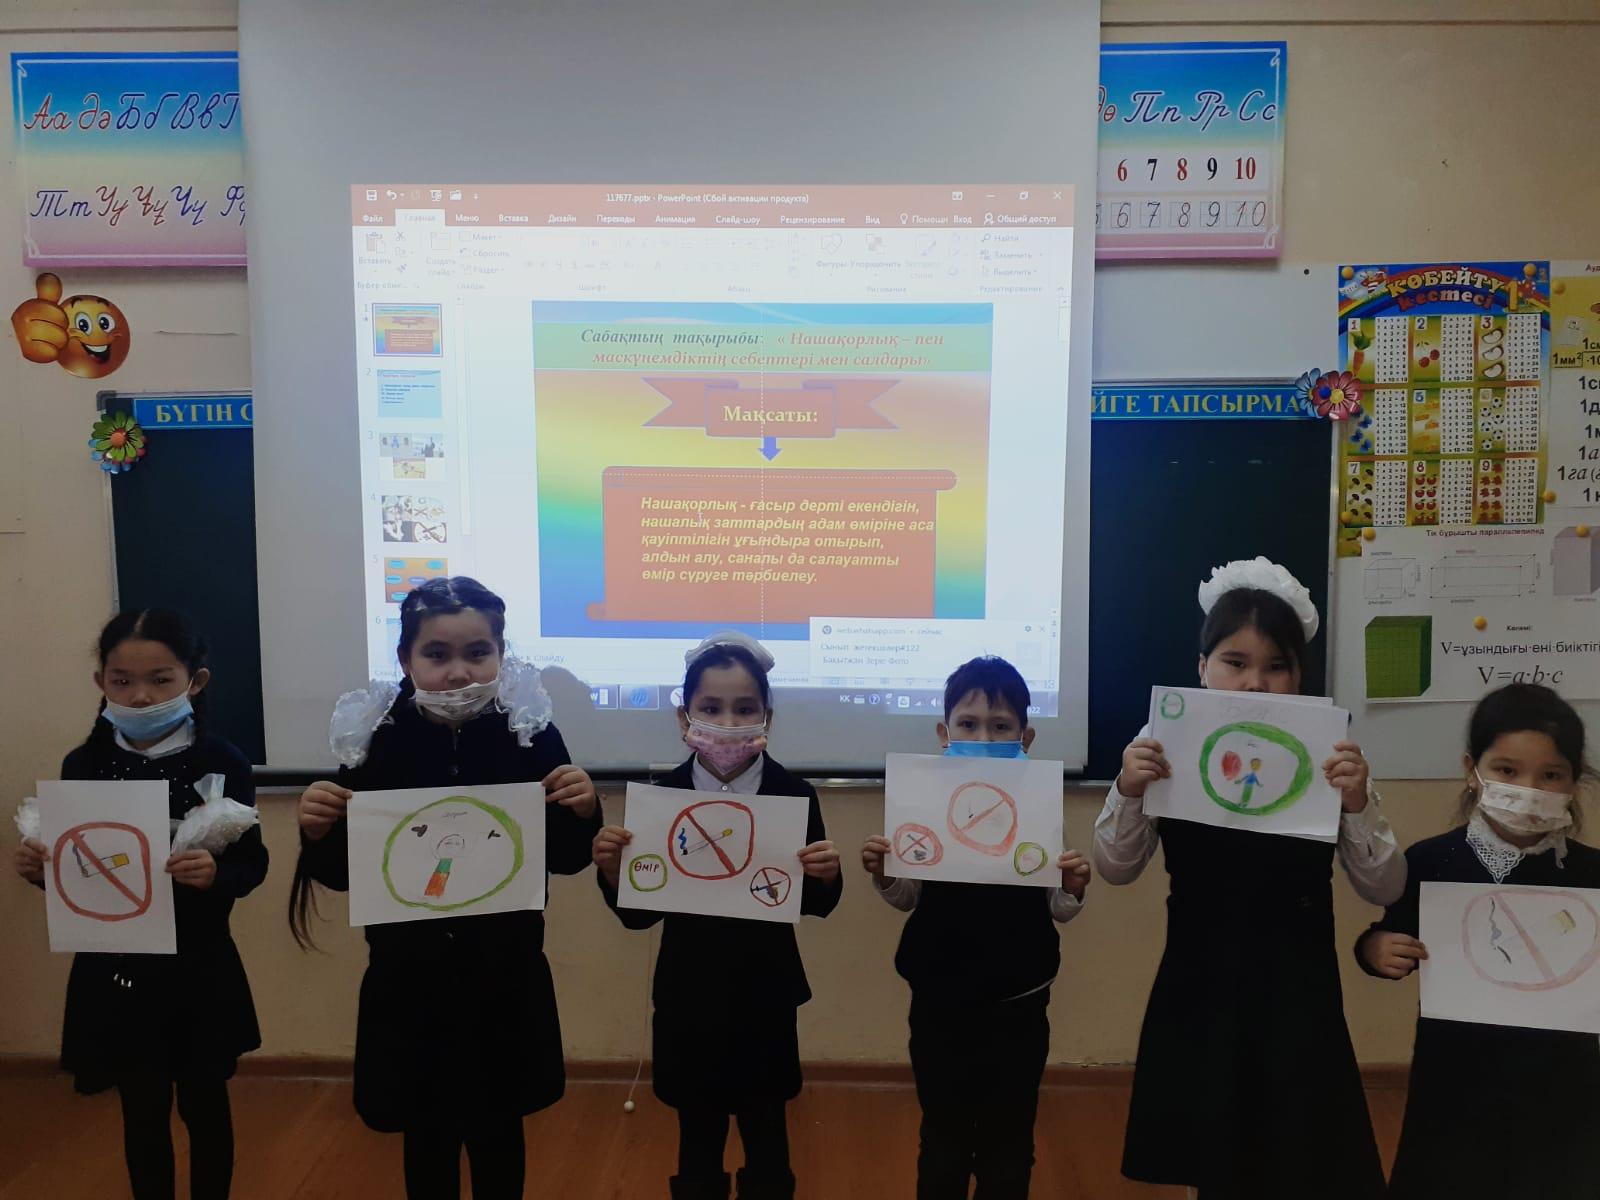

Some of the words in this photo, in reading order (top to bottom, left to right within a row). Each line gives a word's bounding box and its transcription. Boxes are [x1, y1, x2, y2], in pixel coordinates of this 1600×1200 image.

[24, 94, 72, 130] Аа
[78, 93, 111, 130] Әә
[116, 92, 179, 130] Бб
[1124, 91, 1182, 122] Пп
[1189, 91, 1231, 131] Рр
[1239, 90, 1277, 121] Сс
[1117, 159, 1128, 181] 6
[1147, 158, 1158, 181] 7
[1177, 158, 1188, 181] 8
[1207, 157, 1218, 180] 9
[1235, 157, 1257, 180] 10
[30, 190, 92, 217] Тт
[657, 193, 701, 203] PowerPoint
[702, 192, 727, 204] (Сбой
[362, 214, 383, 223] Файл
[455, 213, 480, 223] Меню
[498, 214, 529, 223] Вставка
[548, 213, 577, 224] Дизайн
[596, 214, 636, 225] Переходы
[655, 215, 696, 225] Анимация
[715, 215, 761, 226] Слайд-шоу
[780, 215, 845, 225] Рецензирование
[865, 215, 881, 225] Вид
[953, 214, 973, 224] Вход
[997, 214, 1027, 224] Общий
[1029, 215, 1057, 225] доступ
[1117, 202, 1130, 228] 6
[1147, 202, 1161, 228] 7
[1178, 202, 1191, 228] 8
[1206, 201, 1221, 227] 9
[1236, 201, 1266, 227] 10
[1417, 319, 1425, 330] 2
[1482, 317, 1492, 329] 3
[581, 329, 663, 347] Сабақтың
[790, 332, 899, 349] Нашақорлық
[914, 334, 945, 345] пен
[731, 351, 815, 369] себептері
[817, 354, 848, 367] мен
[1578, 375, 1600, 390] 1с
[1415, 391, 1425, 402] 5
[1148, 394, 1301, 413] ТАПСЫРМА
[155, 404, 233, 423] БҮГІН
[723, 405, 818, 425] Мақсаты:
[1350, 463, 1359, 475] 7
[1416, 461, 1425, 472] 8
[1481, 460, 1490, 471] 9
[641, 497, 738, 512] Нашақорлық
[750, 499, 795, 514] ғасыр
[799, 499, 844, 514] дерті
[847, 500, 920, 515] екендігін,
[713, 517, 805, 533] заттардың
[808, 518, 845, 531] адам
[850, 518, 905, 533] өміріне
[908, 521, 935, 531] аса
[641, 532, 730, 548] қауіптілігін
[734, 535, 811, 550] ұғындыра
[814, 536, 884, 550] отырып,
[641, 550, 691, 563] алдын
[694, 553, 723, 566] алу,
[727, 553, 784, 565] саналы
[788, 552, 805, 565] да
[809, 554, 900, 568] салауатты
[642, 567, 676, 583] өмір
[679, 570, 729, 584] сүруге
[732, 568, 817, 585] тәрбиелеу.
